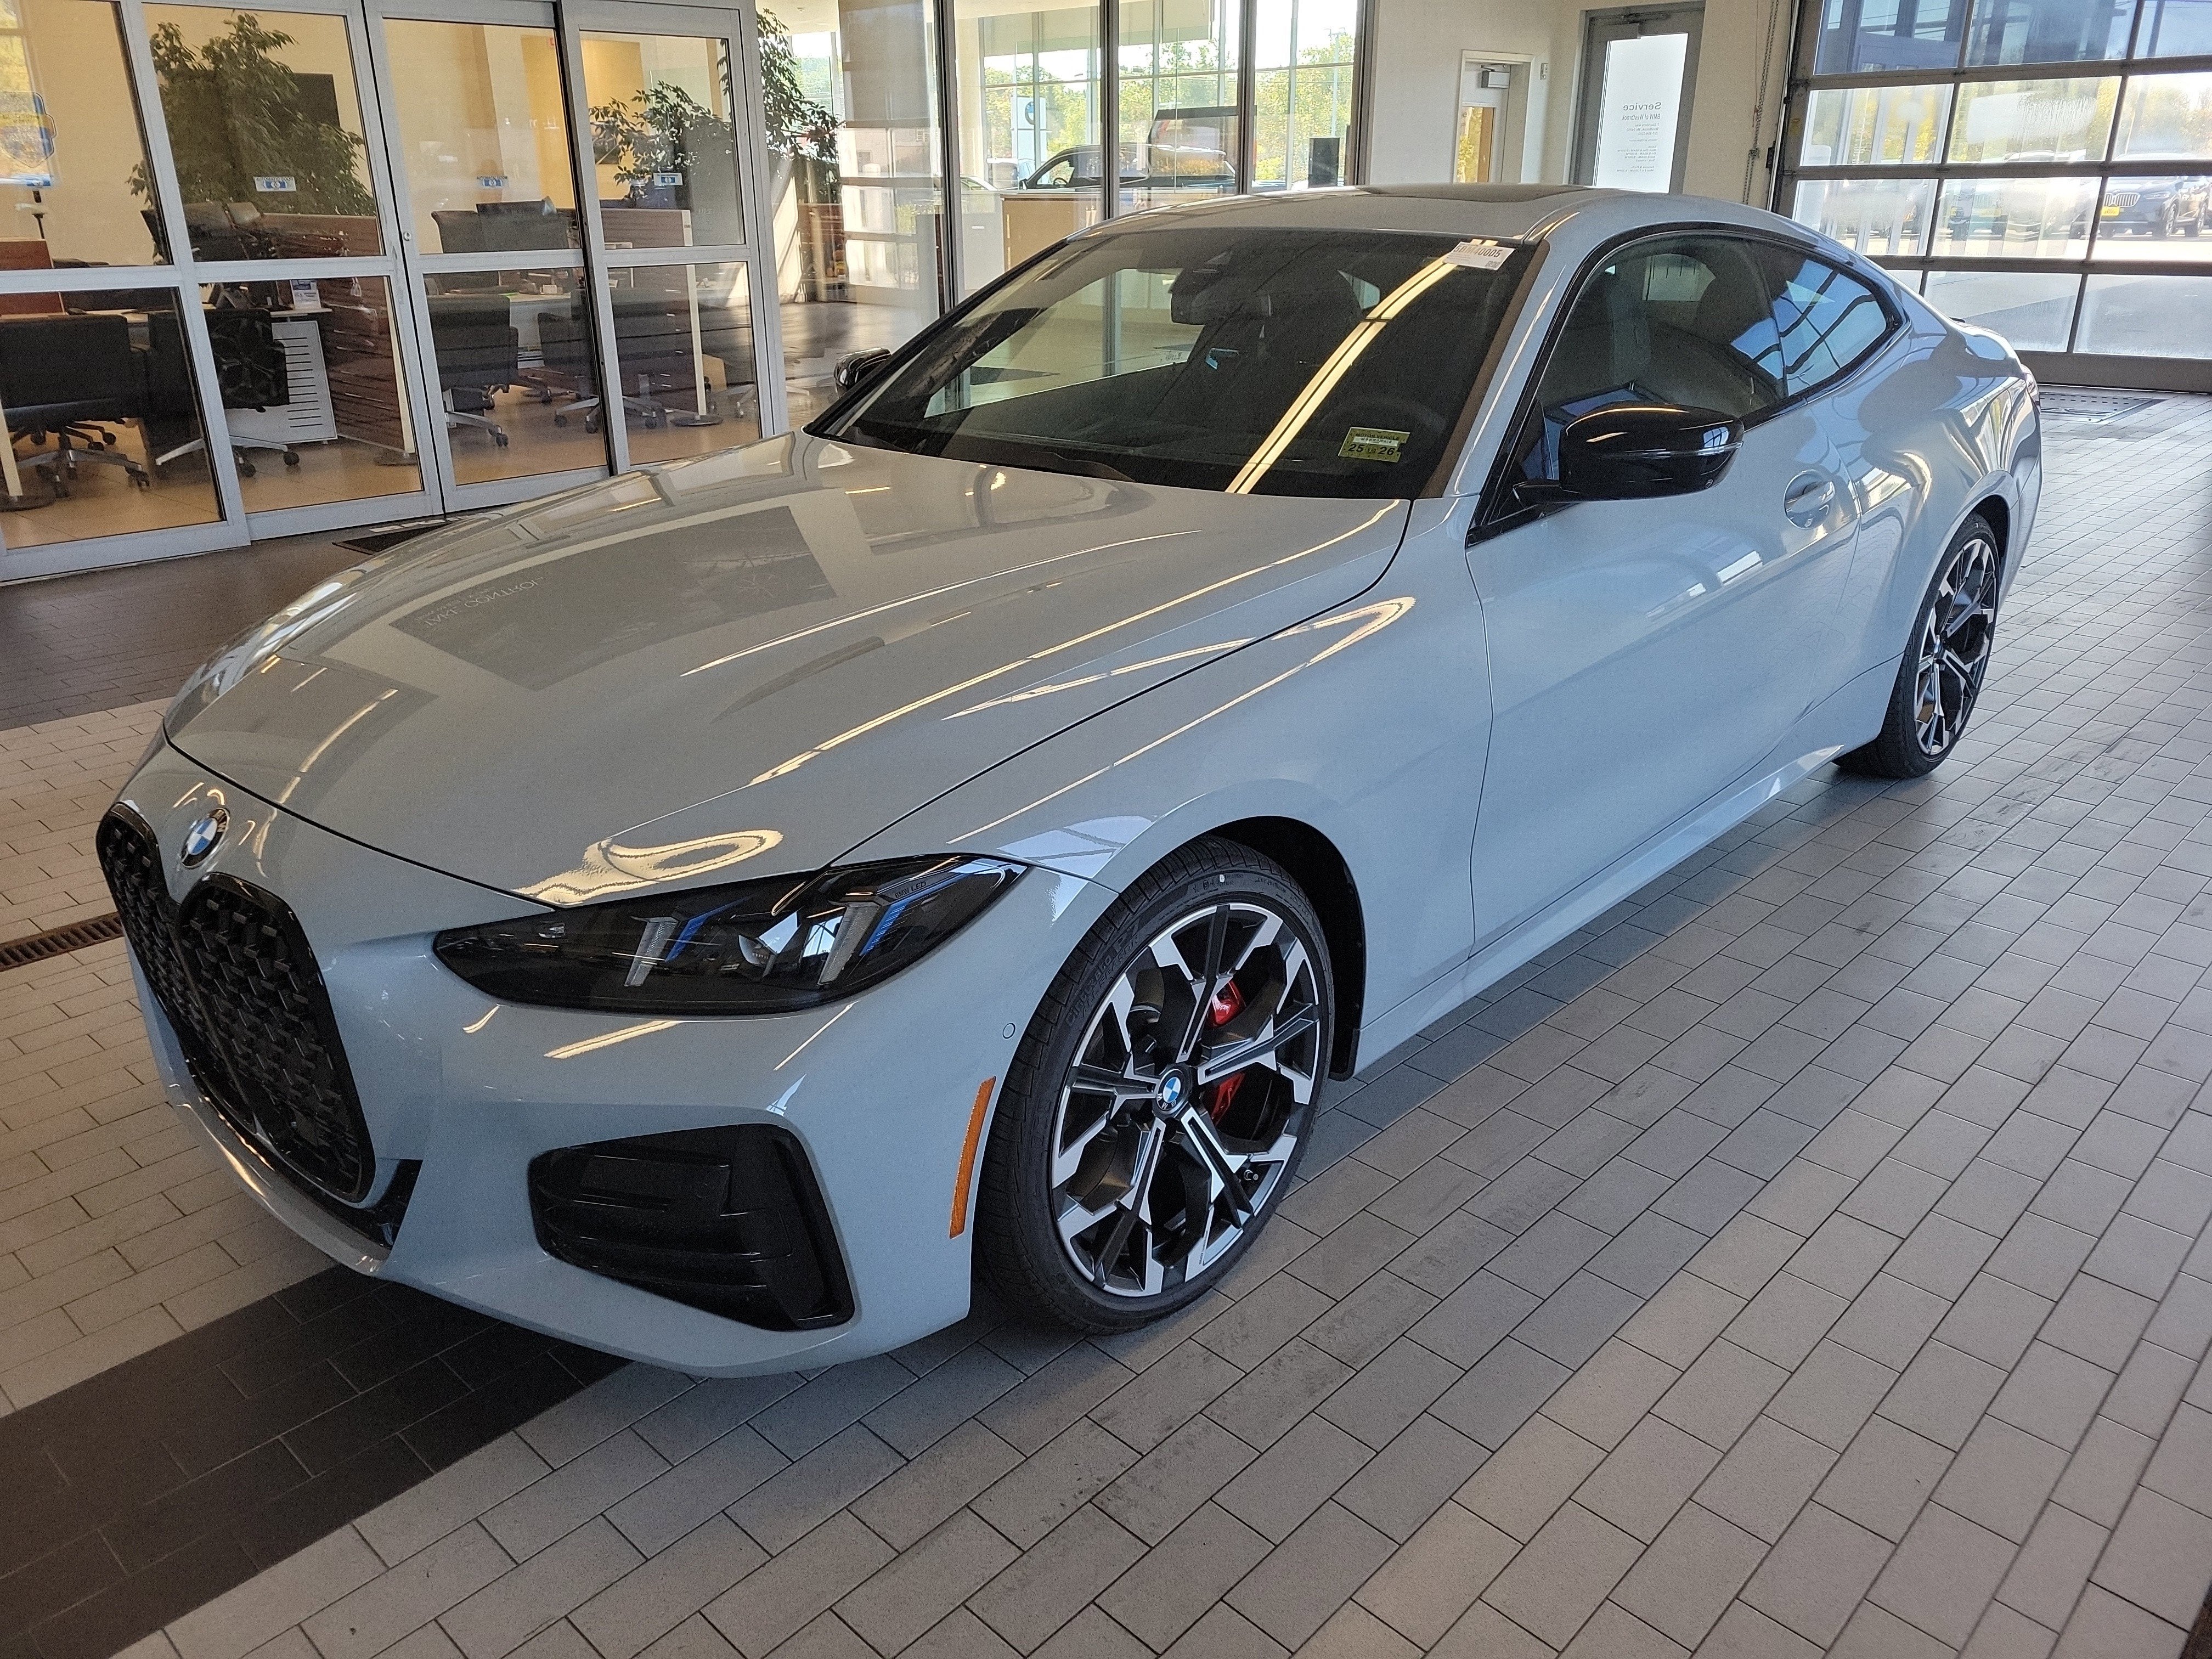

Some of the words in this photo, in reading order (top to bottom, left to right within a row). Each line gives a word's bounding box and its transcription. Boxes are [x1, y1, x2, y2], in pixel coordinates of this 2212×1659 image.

[1454, 246, 1503, 258] 5BM40005
[1348, 443, 1365, 452] 25
[1378, 447, 1395, 455] 26
[895, 887, 909, 898] BMW
[911, 881, 926, 891] LED
[1065, 954, 1111, 1026] Cinturato
[1113, 918, 1140, 953] P7
[1157, 1093, 1176, 1109] BMW
